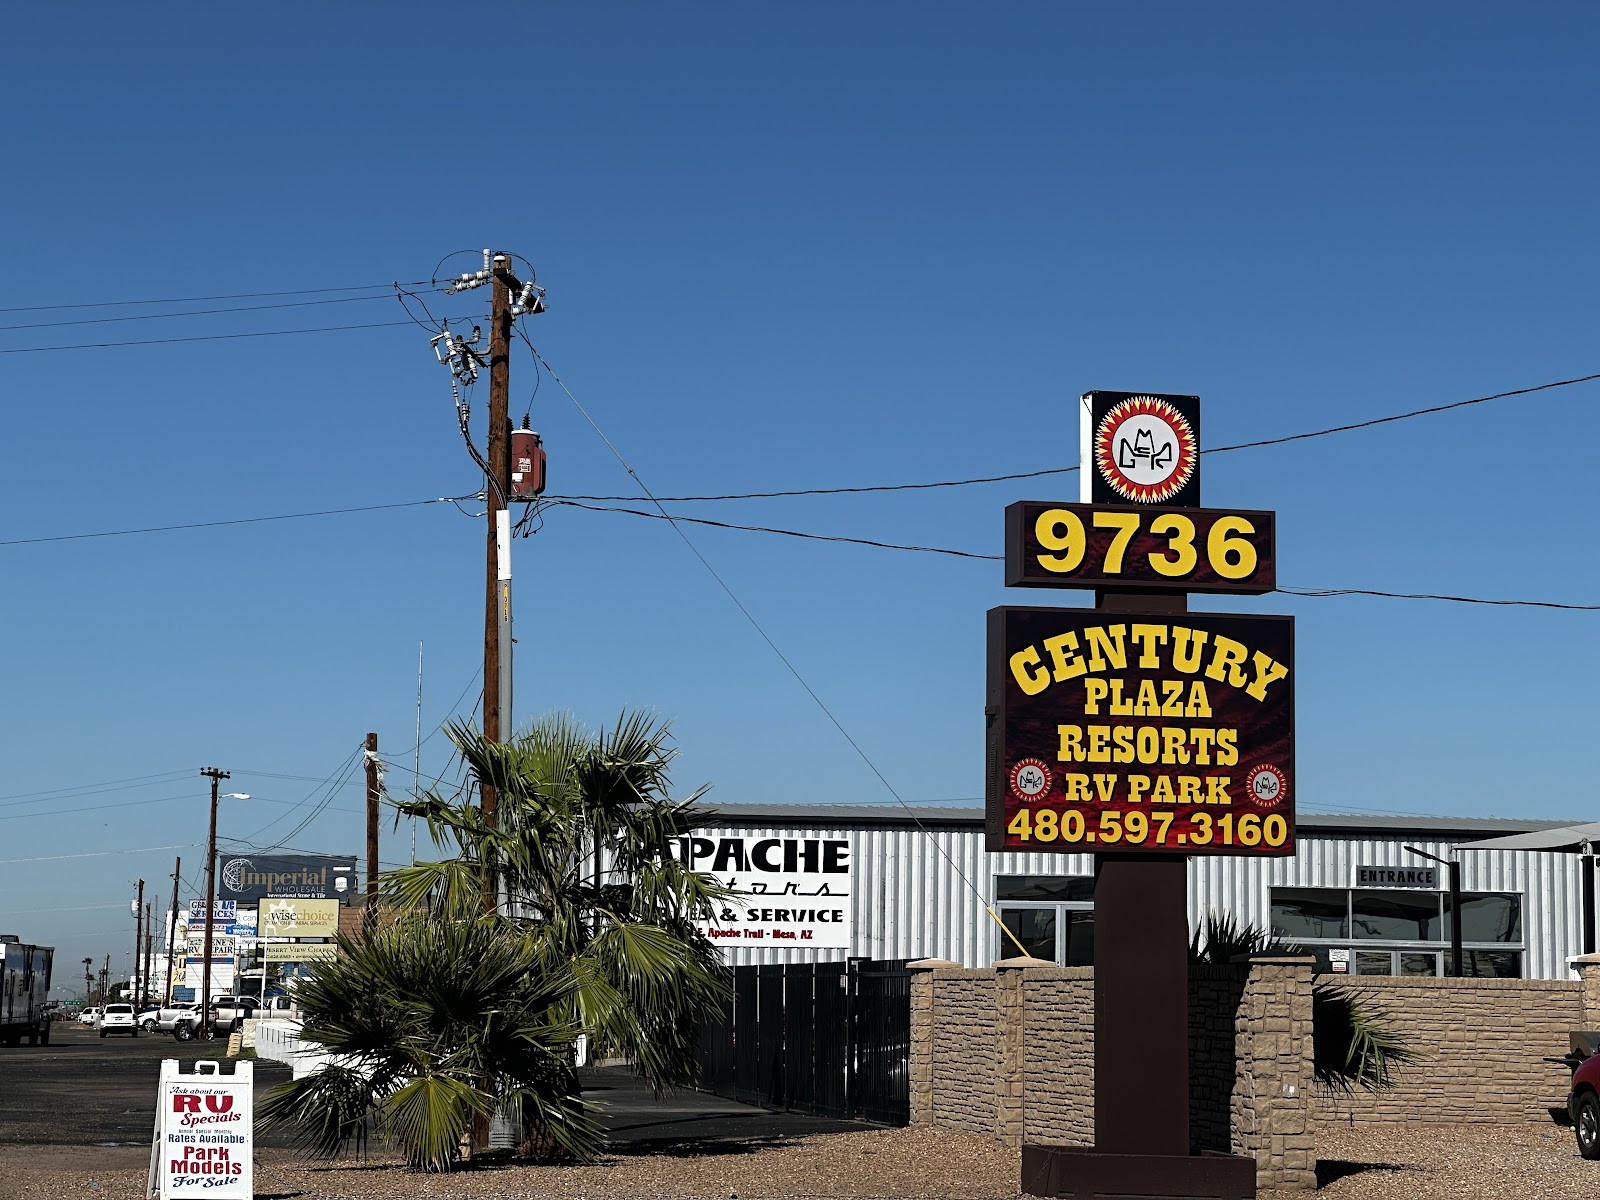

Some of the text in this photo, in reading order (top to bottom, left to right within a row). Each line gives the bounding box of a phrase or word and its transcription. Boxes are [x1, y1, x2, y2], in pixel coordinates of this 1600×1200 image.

[1035, 509, 1258, 580] 9736
[1009, 623, 1289, 702] CENTURY
[1084, 678, 1213, 718] PLAZA
[1056, 724, 1239, 766] RESORTS
[1065, 773, 1232, 805] RV PARK
[1008, 808, 1287, 847] 480.597.3160
[240, 866, 326, 892] Imperial
[1360, 870, 1433, 884] ENTRANCE
[747, 908, 843, 922] SERVICE
[708, 928, 741, 940] Apache
[743, 928, 764, 939] Trail
[800, 929, 813, 940] AZ
[170, 1086, 188, 1094] Ask
[173, 1094, 233, 1113] RV
[180, 1112, 241, 1128] Specials
[168, 1134, 245, 1144] Rates Available
[183, 1146, 229, 1160] Park
[170, 1160, 242, 1175] Models
[172, 1176, 238, 1188] For Sale
